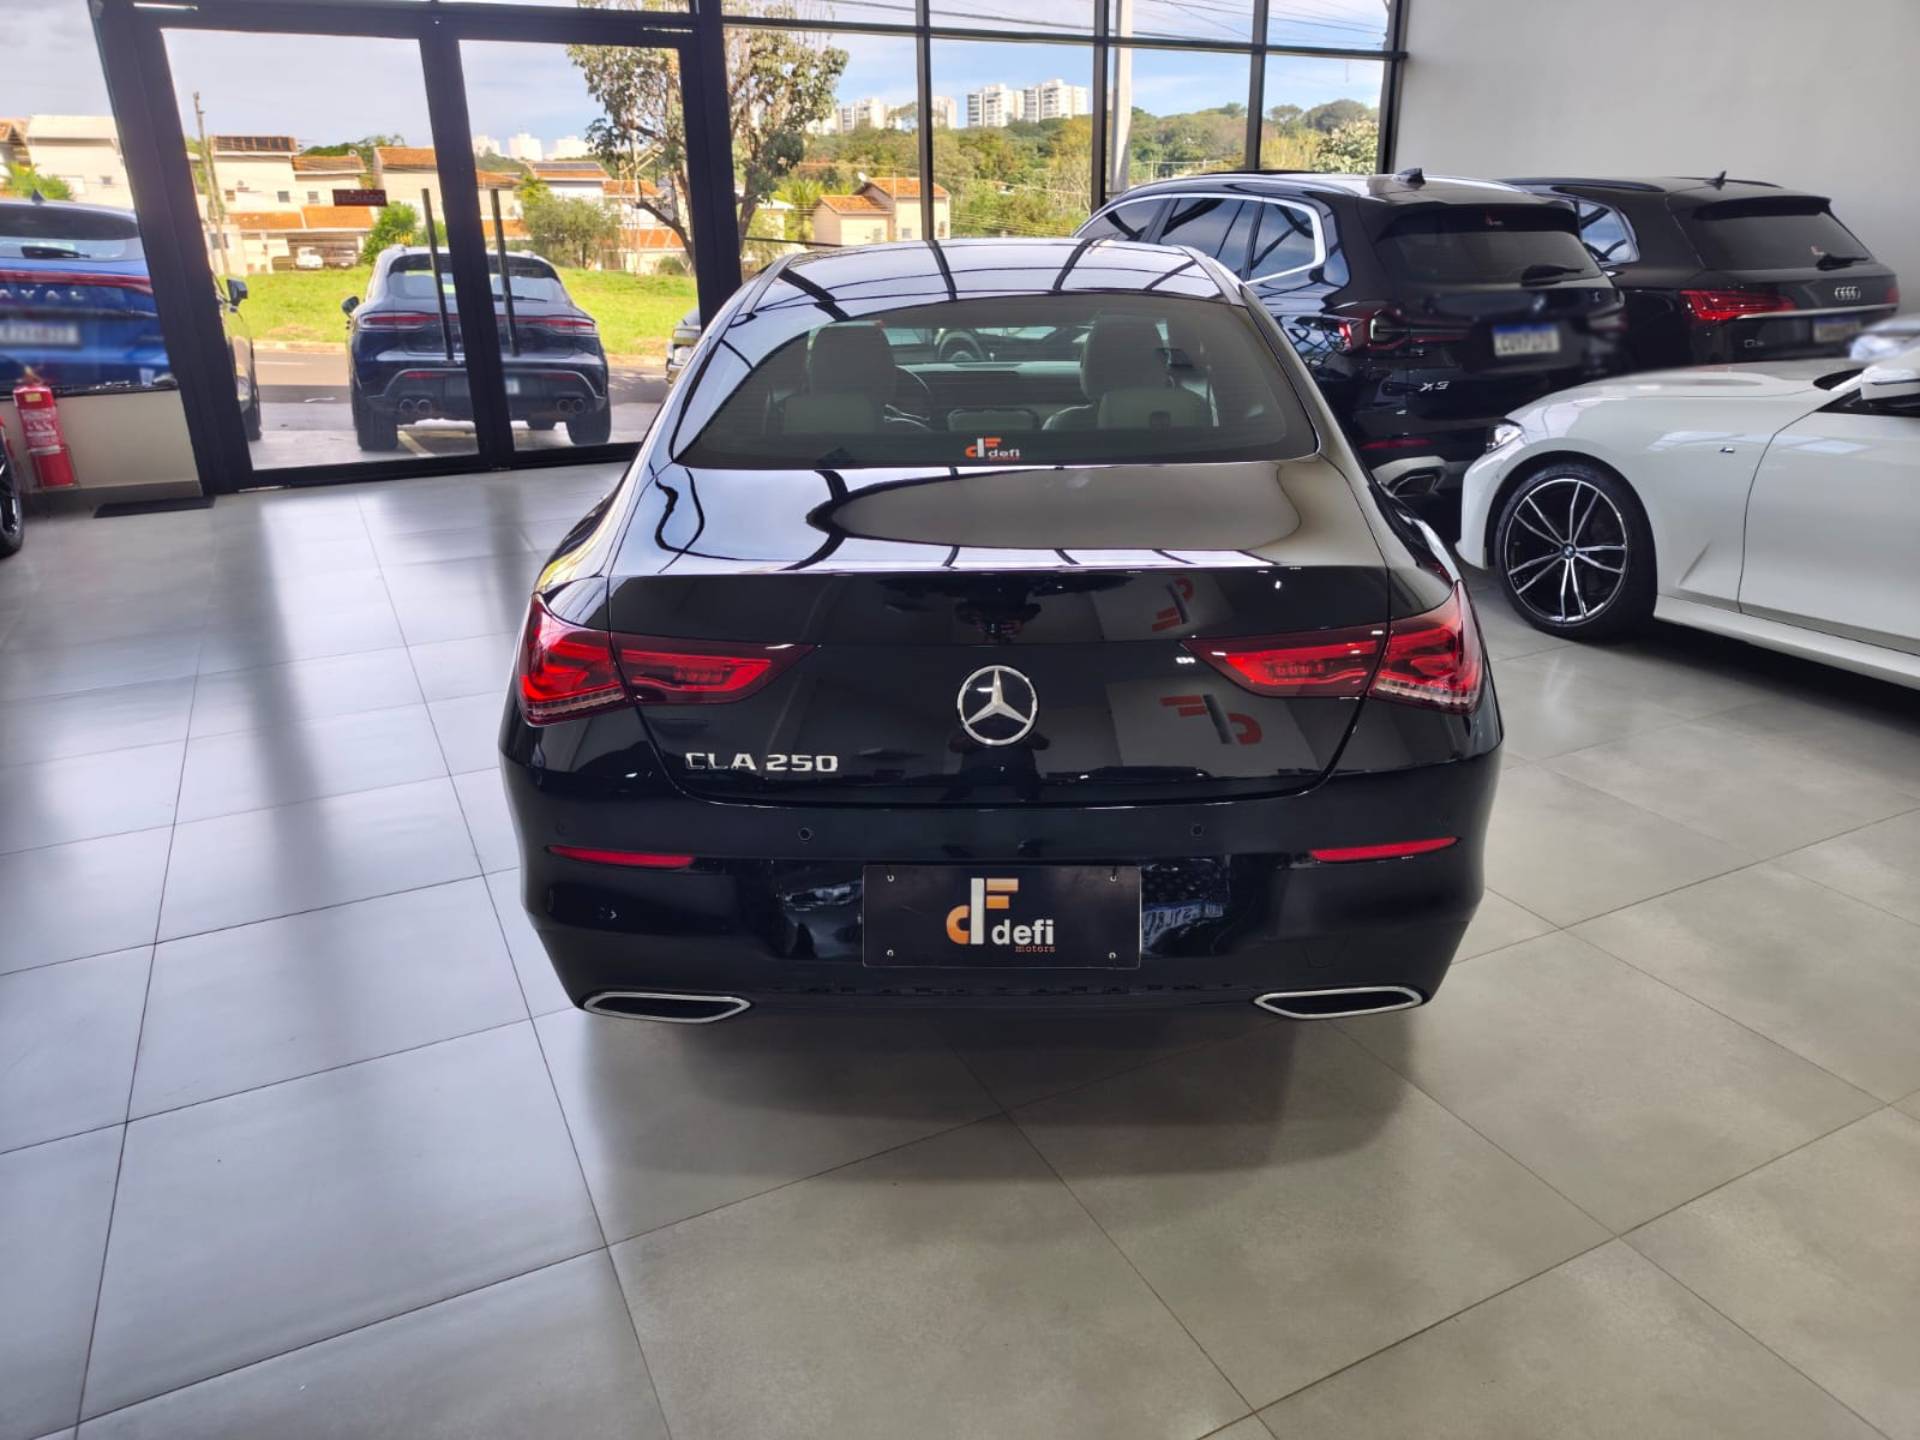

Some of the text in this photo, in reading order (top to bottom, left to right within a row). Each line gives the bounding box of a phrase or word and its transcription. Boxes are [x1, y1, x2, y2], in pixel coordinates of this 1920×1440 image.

[1419, 380, 1450, 392] X3
[685, 752, 838, 772] CLA 250
[991, 918, 1054, 945] defi
[1015, 944, 1056, 953] motors
